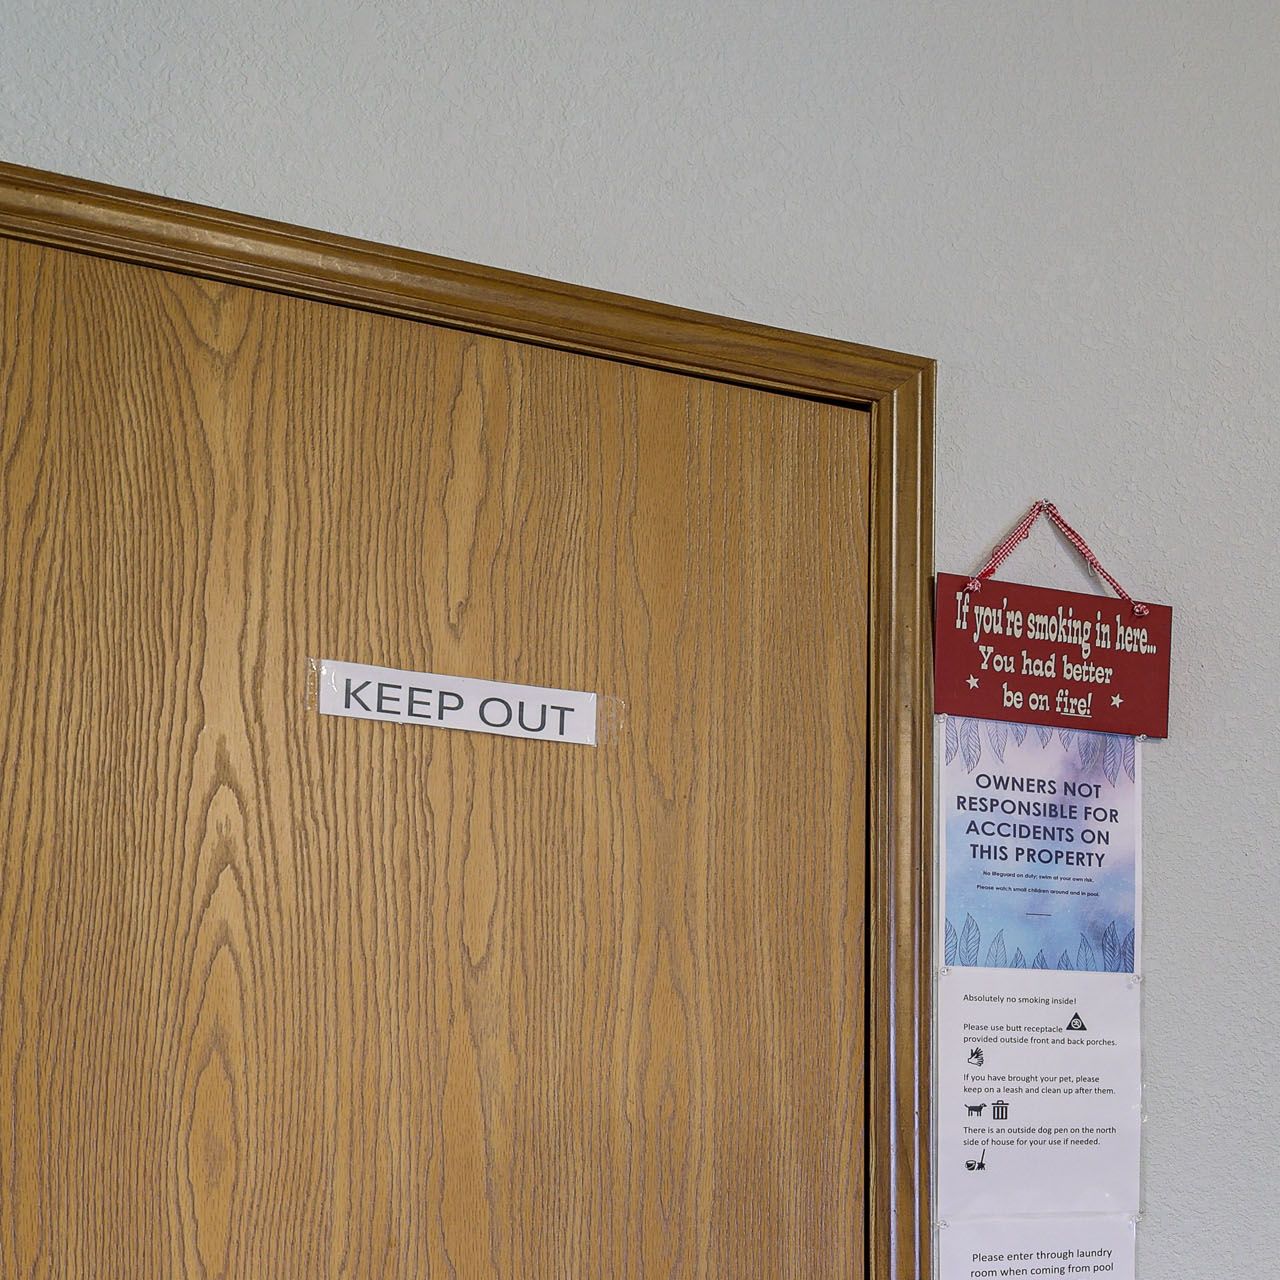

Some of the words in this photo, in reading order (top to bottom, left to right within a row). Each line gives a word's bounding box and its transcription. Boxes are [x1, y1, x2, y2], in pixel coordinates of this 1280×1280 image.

[955, 591, 970, 630] If
[973, 598, 1024, 643] you're
[1027, 606, 1091, 659] smoking
[1095, 611, 1111, 649] in
[1115, 614, 1157, 654] here...
[978, 645, 1015, 673] You
[1021, 651, 1056, 679] had
[1062, 655, 1113, 684] better
[344, 678, 464, 720] KEEP
[478, 697, 575, 735] OUT
[1002, 683, 1024, 709] be
[1028, 693, 1050, 711] on
[1056, 689, 1093, 715] fire!
[975, 773, 1057, 795] OWNERS
[1064, 781, 1101, 799] NOT
[956, 796, 1078, 820] RESPONSIBLE
[1084, 806, 1119, 824] FOR
[965, 820, 1074, 843] ACCIDENTS
[1080, 829, 1110, 845] ON
[970, 843, 1008, 861] THIS
[1015, 847, 1105, 868] PROPERTY
[963, 994, 1004, 1003] Absolutely
[1018, 997, 1049, 1005] smoking
[1024, 1025, 1063, 1034] receptacle
[1031, 1036, 1049, 1044] front
[1008, 1075, 1038, 1083] brought
[1076, 1075, 1099, 1083] please
[964, 1086, 982, 1094] keep
[1038, 1126, 1052, 1135] dog
[973, 1253, 1004, 1262] Please
[1007, 1253, 1033, 1261] enter
[1037, 1250, 1073, 1260] through
[1077, 1248, 1112, 1258] laundry
[1000, 1268, 1027, 1276] when
[1031, 1265, 1065, 1275] coming
[1068, 1264, 1090, 1272] from
[1093, 1262, 1113, 1273] pool
